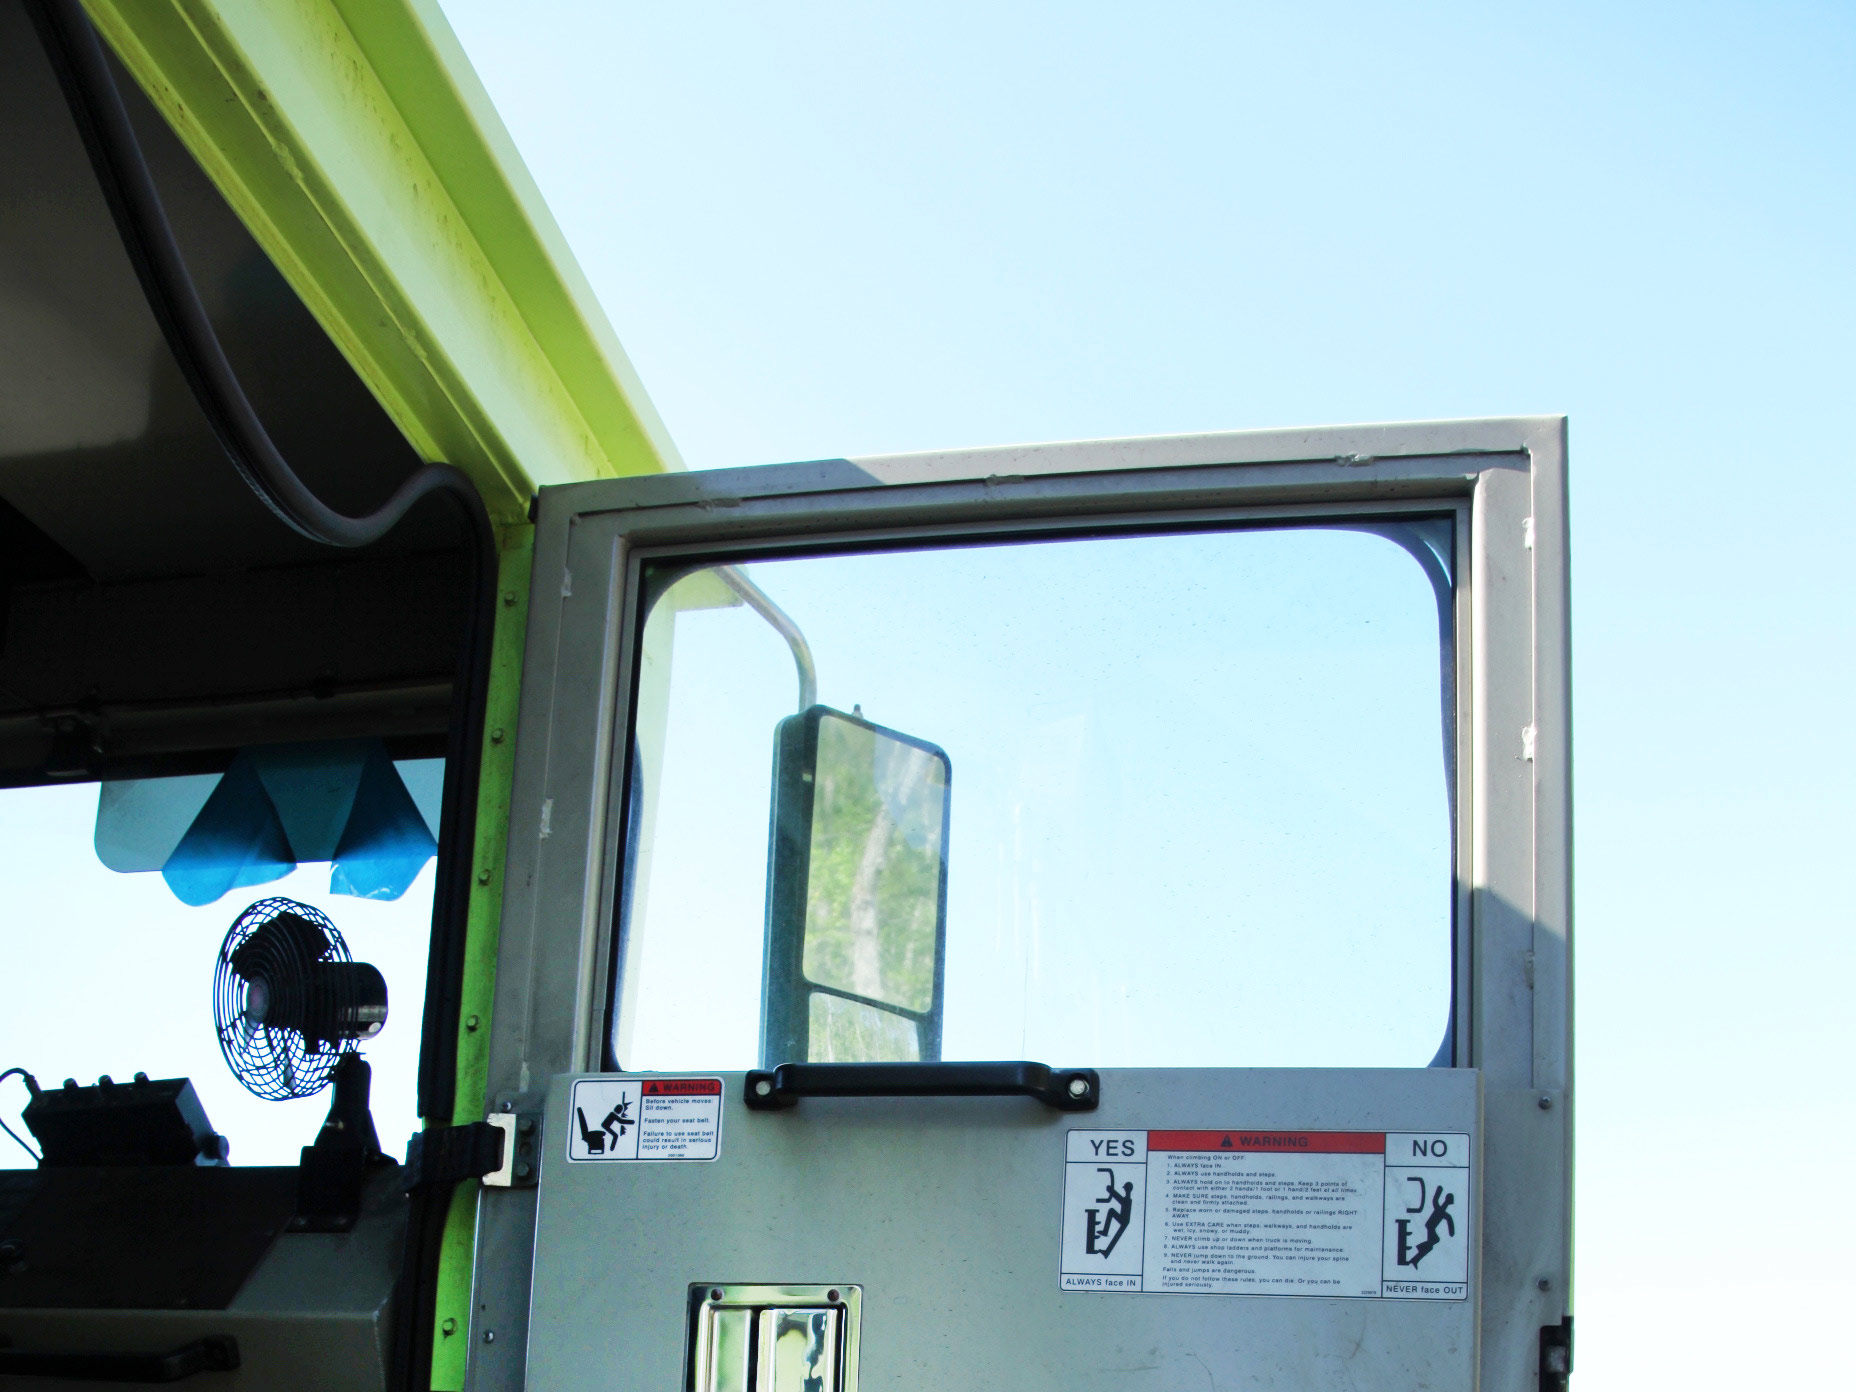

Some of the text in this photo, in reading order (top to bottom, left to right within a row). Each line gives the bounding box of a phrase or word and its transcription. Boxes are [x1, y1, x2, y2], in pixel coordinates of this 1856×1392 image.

[663, 1083, 715, 1091] WARNING
[1239, 1136, 1309, 1148] WARNING
[1090, 1139, 1136, 1157] YES
[1412, 1139, 1448, 1158] NO
[1065, 1278, 1136, 1288] ALWAYS face IN
[1386, 1285, 1417, 1294] NEVER
[1419, 1285, 1440, 1295] face
[1443, 1286, 1463, 1295] OUT
